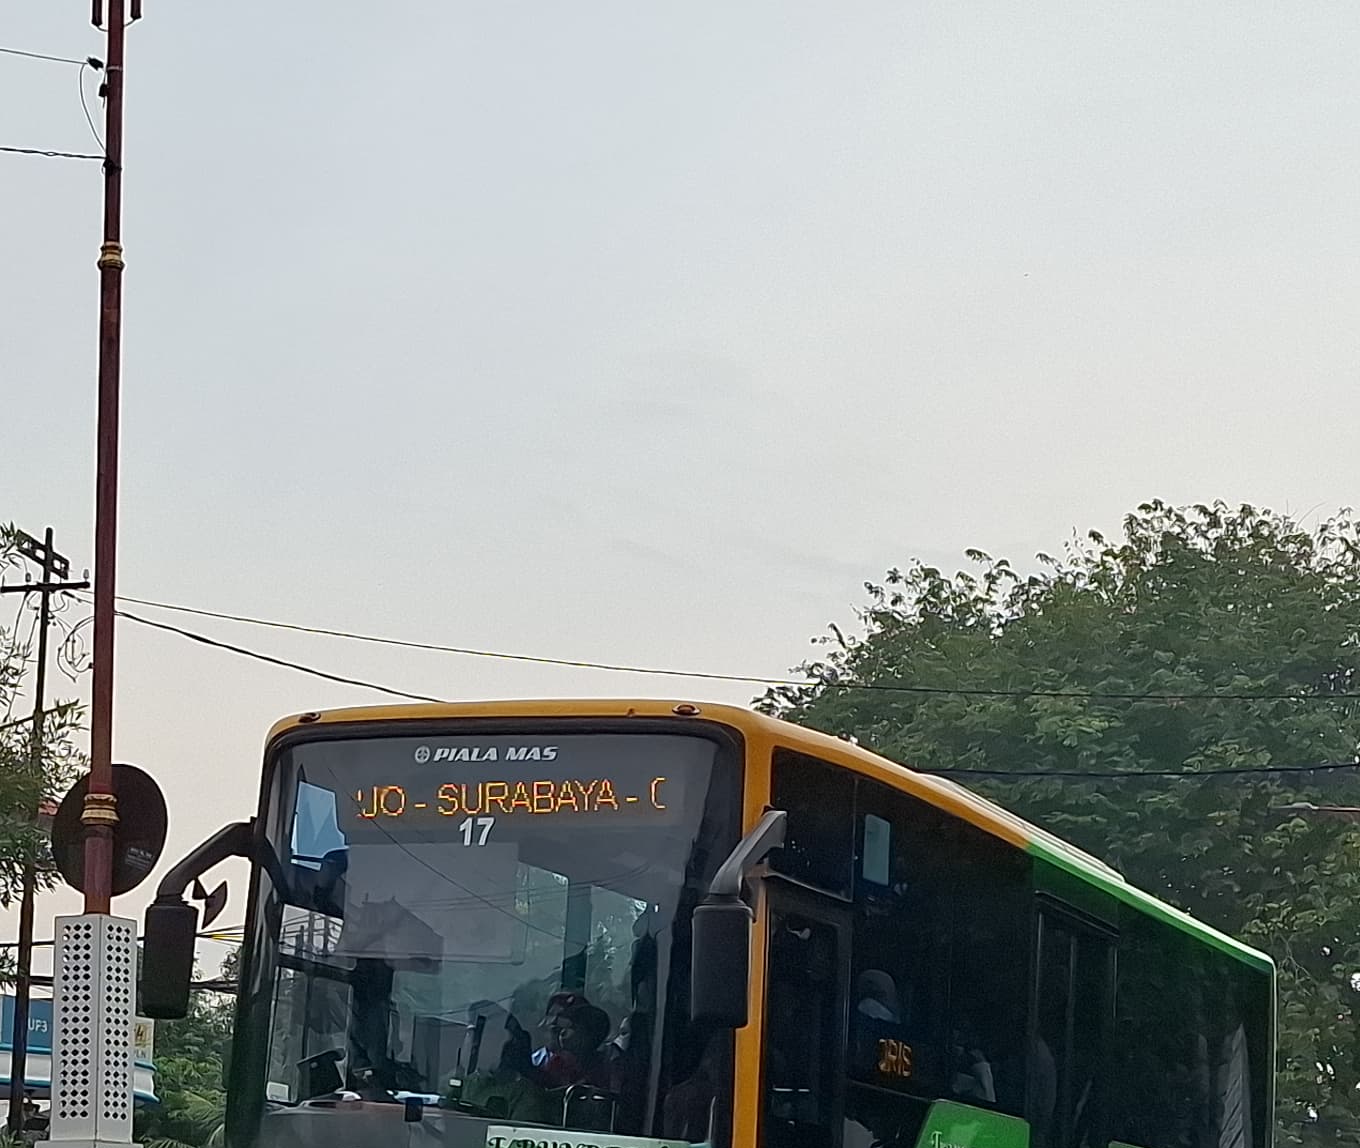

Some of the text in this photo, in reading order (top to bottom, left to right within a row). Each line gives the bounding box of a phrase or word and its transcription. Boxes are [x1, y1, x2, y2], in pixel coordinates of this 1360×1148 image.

[433, 746, 558, 762] PIALA MAS
[356, 785, 406, 818] JO
[437, 779, 619, 815] SURABAYA
[458, 816, 495, 846] 17
[27, 1017, 48, 1033] UP3
